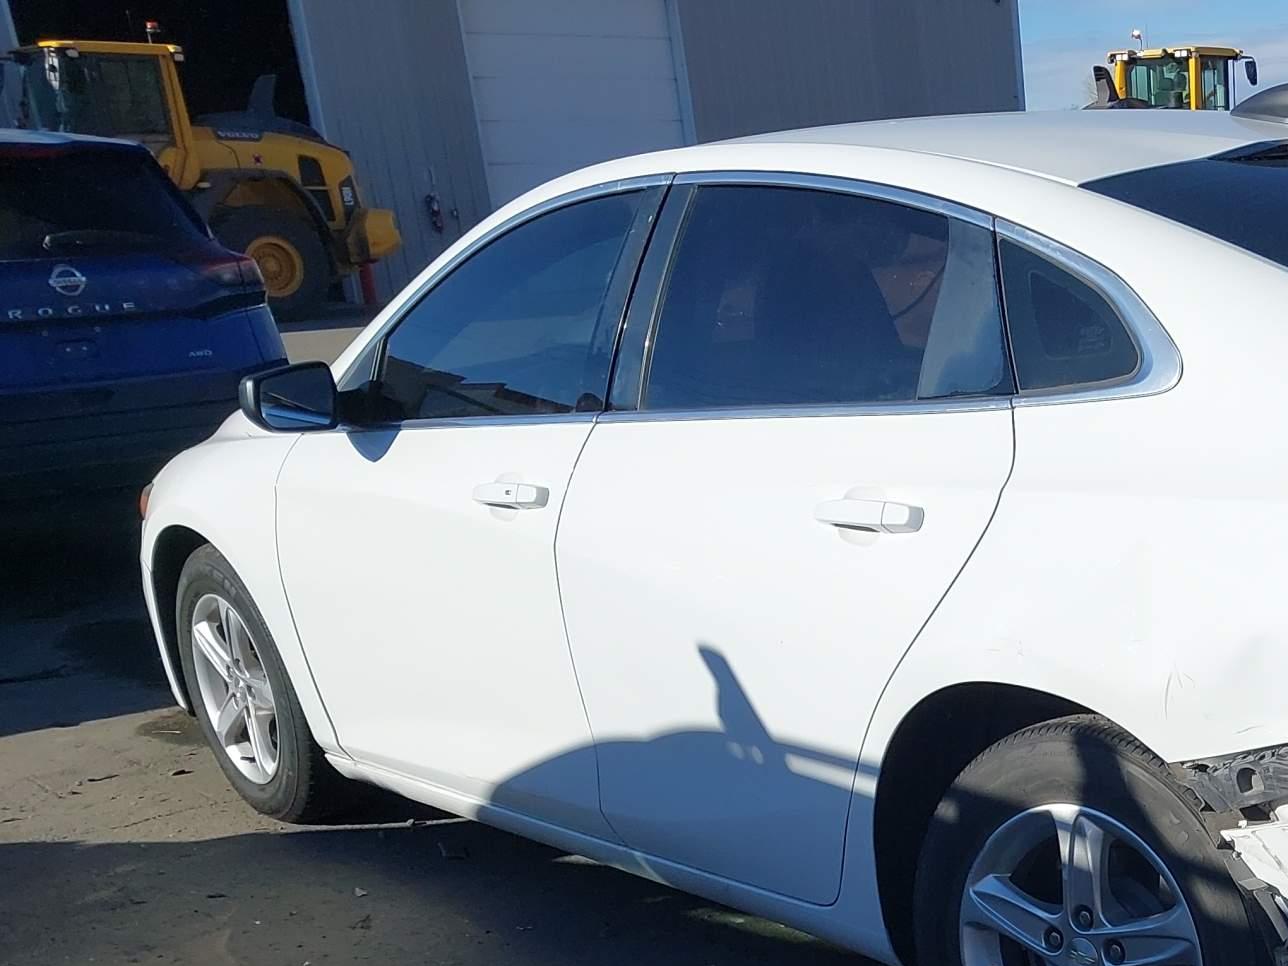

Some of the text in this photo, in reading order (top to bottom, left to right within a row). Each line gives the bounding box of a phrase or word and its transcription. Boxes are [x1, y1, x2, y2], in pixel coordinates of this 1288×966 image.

[217, 130, 260, 139] VOLVO
[7, 302, 137, 320] ROGUE
[188, 349, 213, 358] AWD
